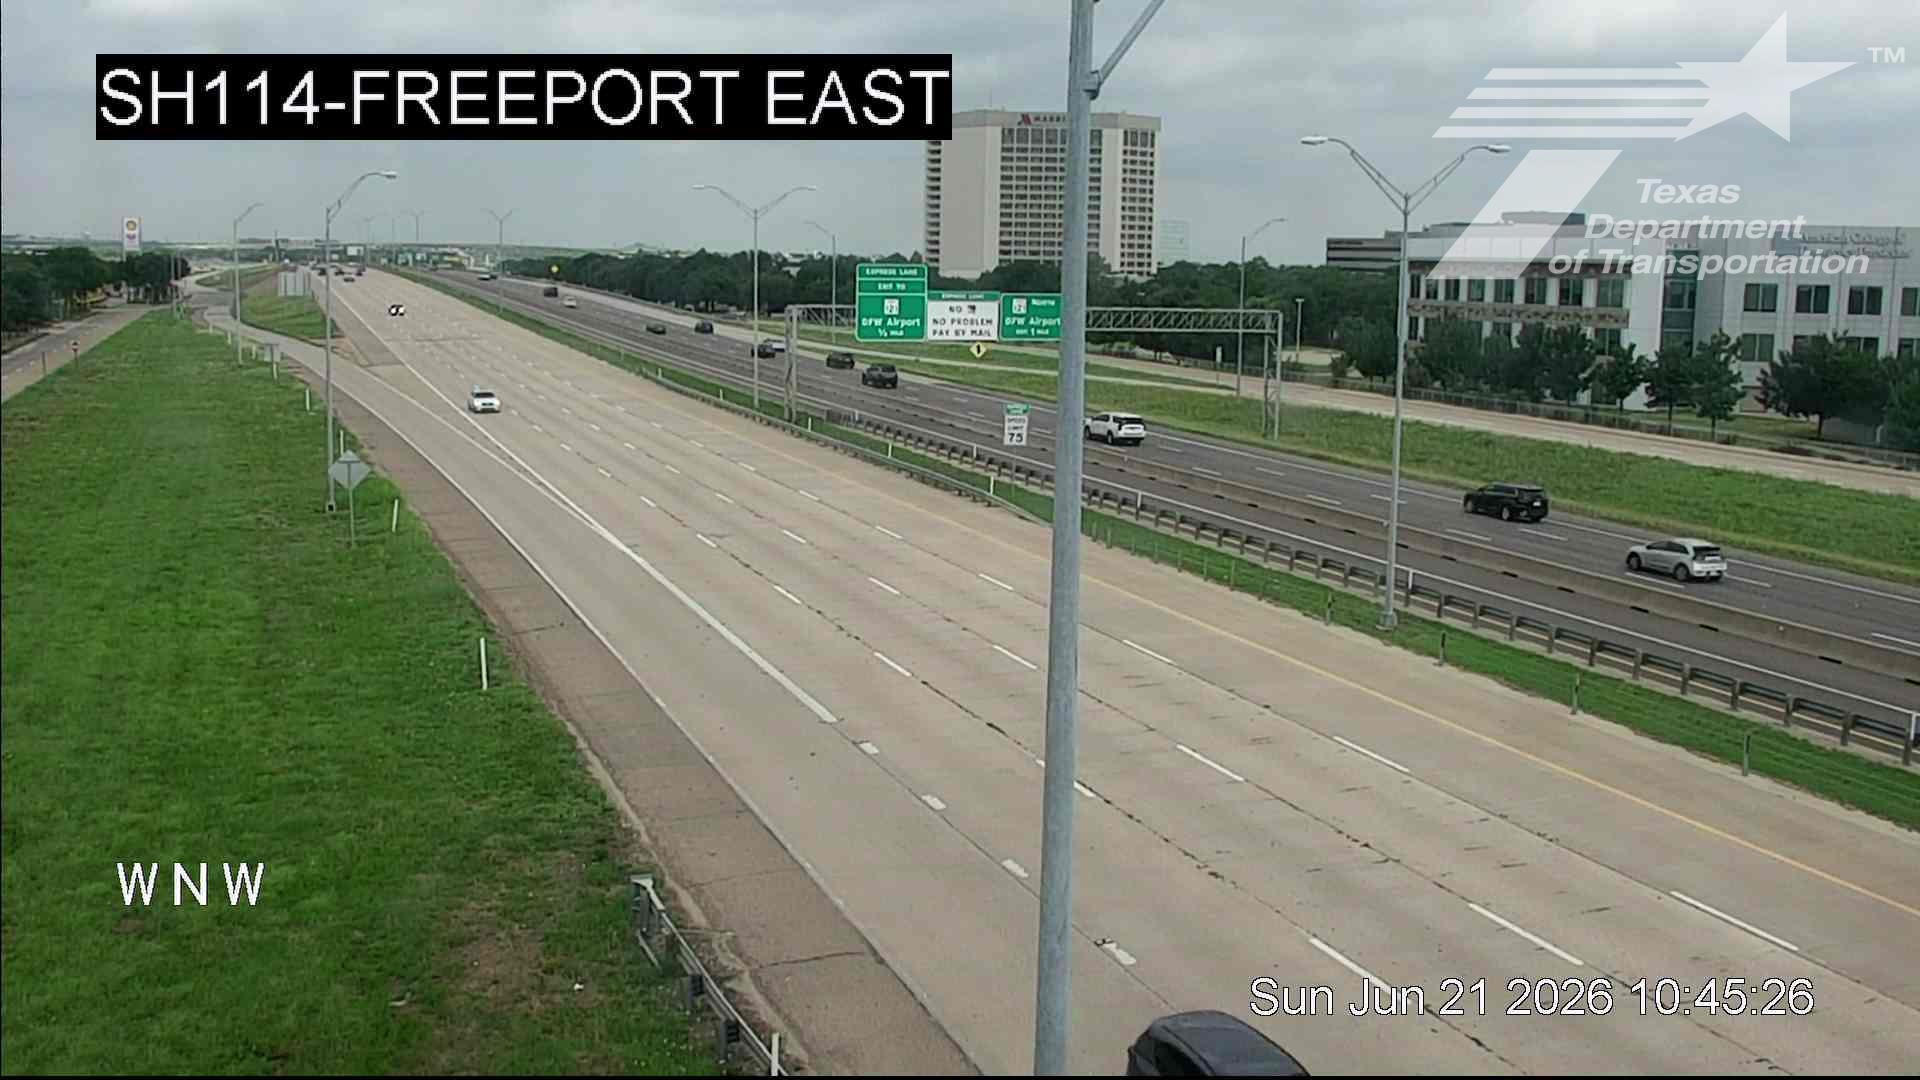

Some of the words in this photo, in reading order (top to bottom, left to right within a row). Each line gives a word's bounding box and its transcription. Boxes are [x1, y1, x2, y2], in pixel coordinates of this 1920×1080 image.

[948, 305, 962, 313] NO
[861, 317, 883, 326] DFW
[886, 316, 921, 328] Airport
[932, 318, 946, 326] NO
[951, 318, 993, 326] PROBLEM
[1004, 317, 1026, 326] DFW
[1029, 316, 1061, 328] Airport
[970, 329, 992, 337] MAIL
[1008, 432, 1024, 443] 75
